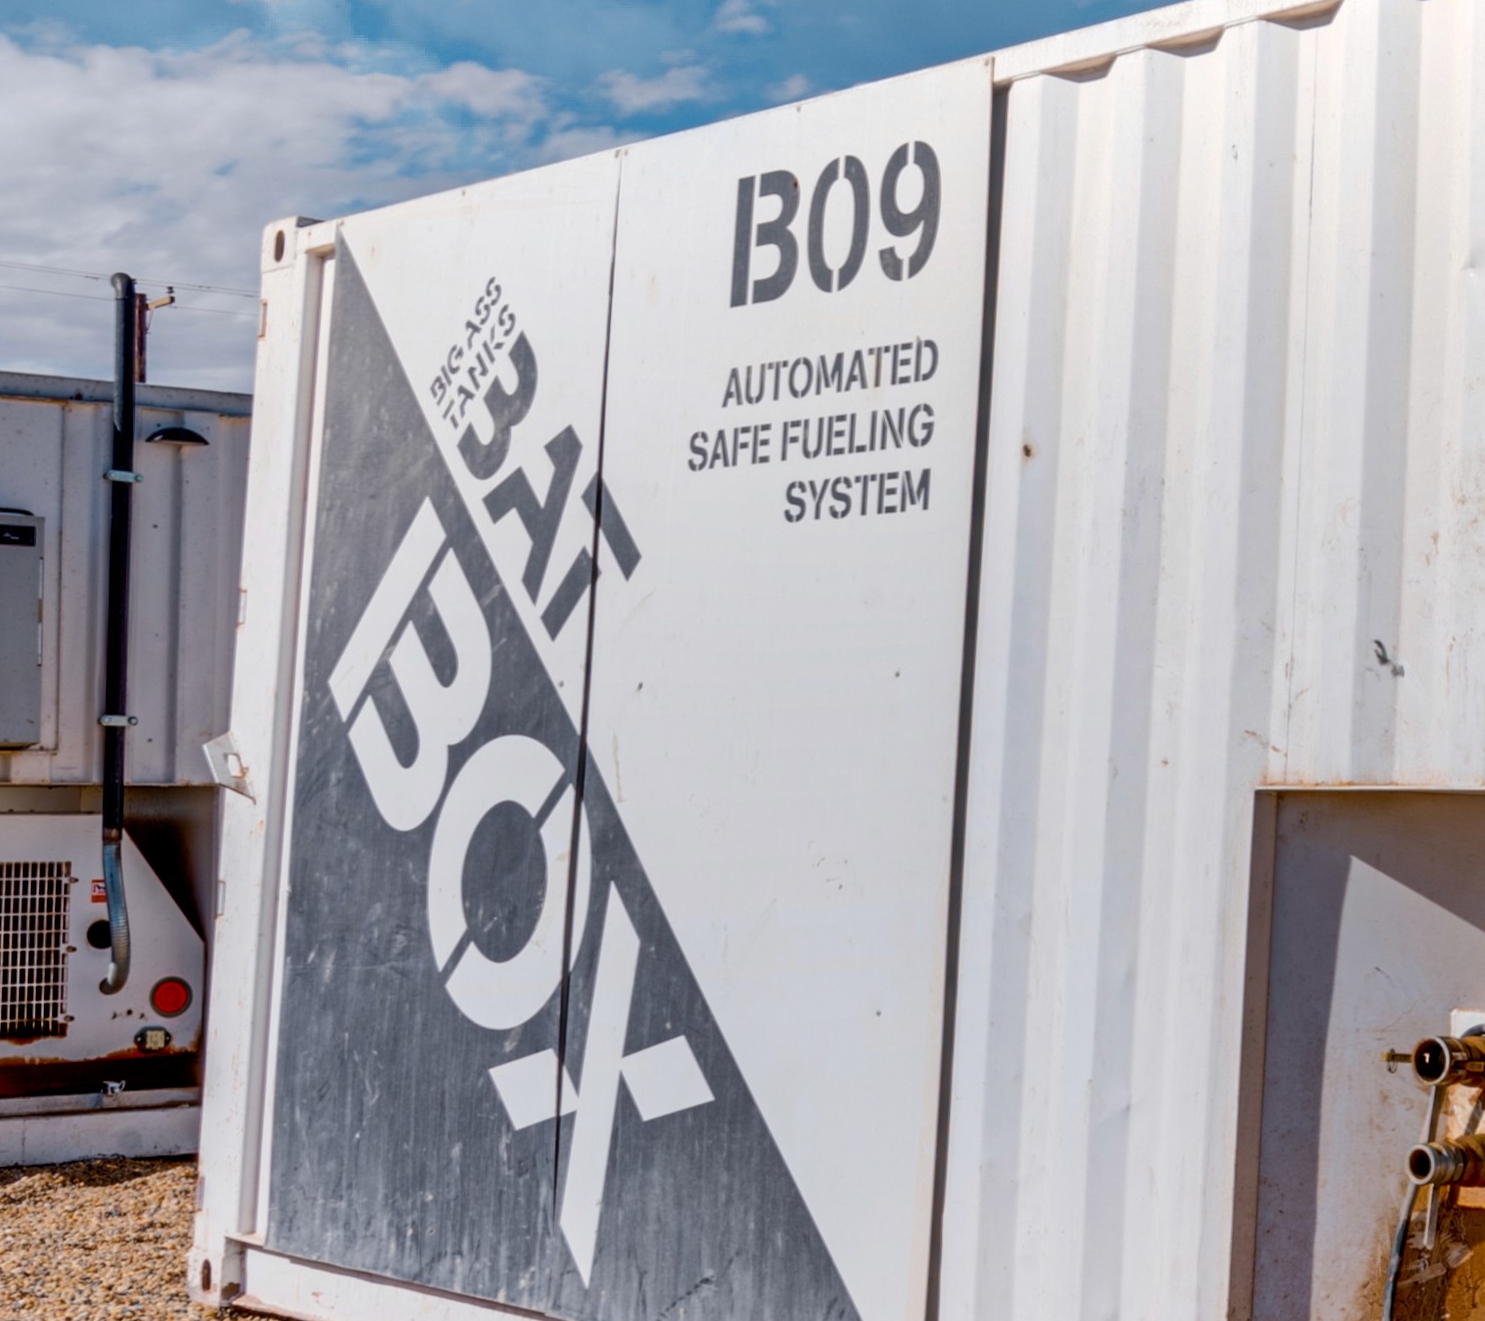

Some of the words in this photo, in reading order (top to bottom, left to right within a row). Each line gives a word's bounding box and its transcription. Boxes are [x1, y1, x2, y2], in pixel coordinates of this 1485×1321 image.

[730, 140, 942, 308] B09
[428, 343, 464, 407] BIG
[464, 276, 502, 350] ASS
[441, 304, 516, 430] TANKS
[722, 337, 939, 409] AUTOMATED
[457, 329, 643, 643] BAT
[688, 422, 772, 472] SAFE
[781, 403, 935, 462] FUELING
[783, 468, 931, 524] SYSTEM
[328, 497, 716, 1290] BOX
